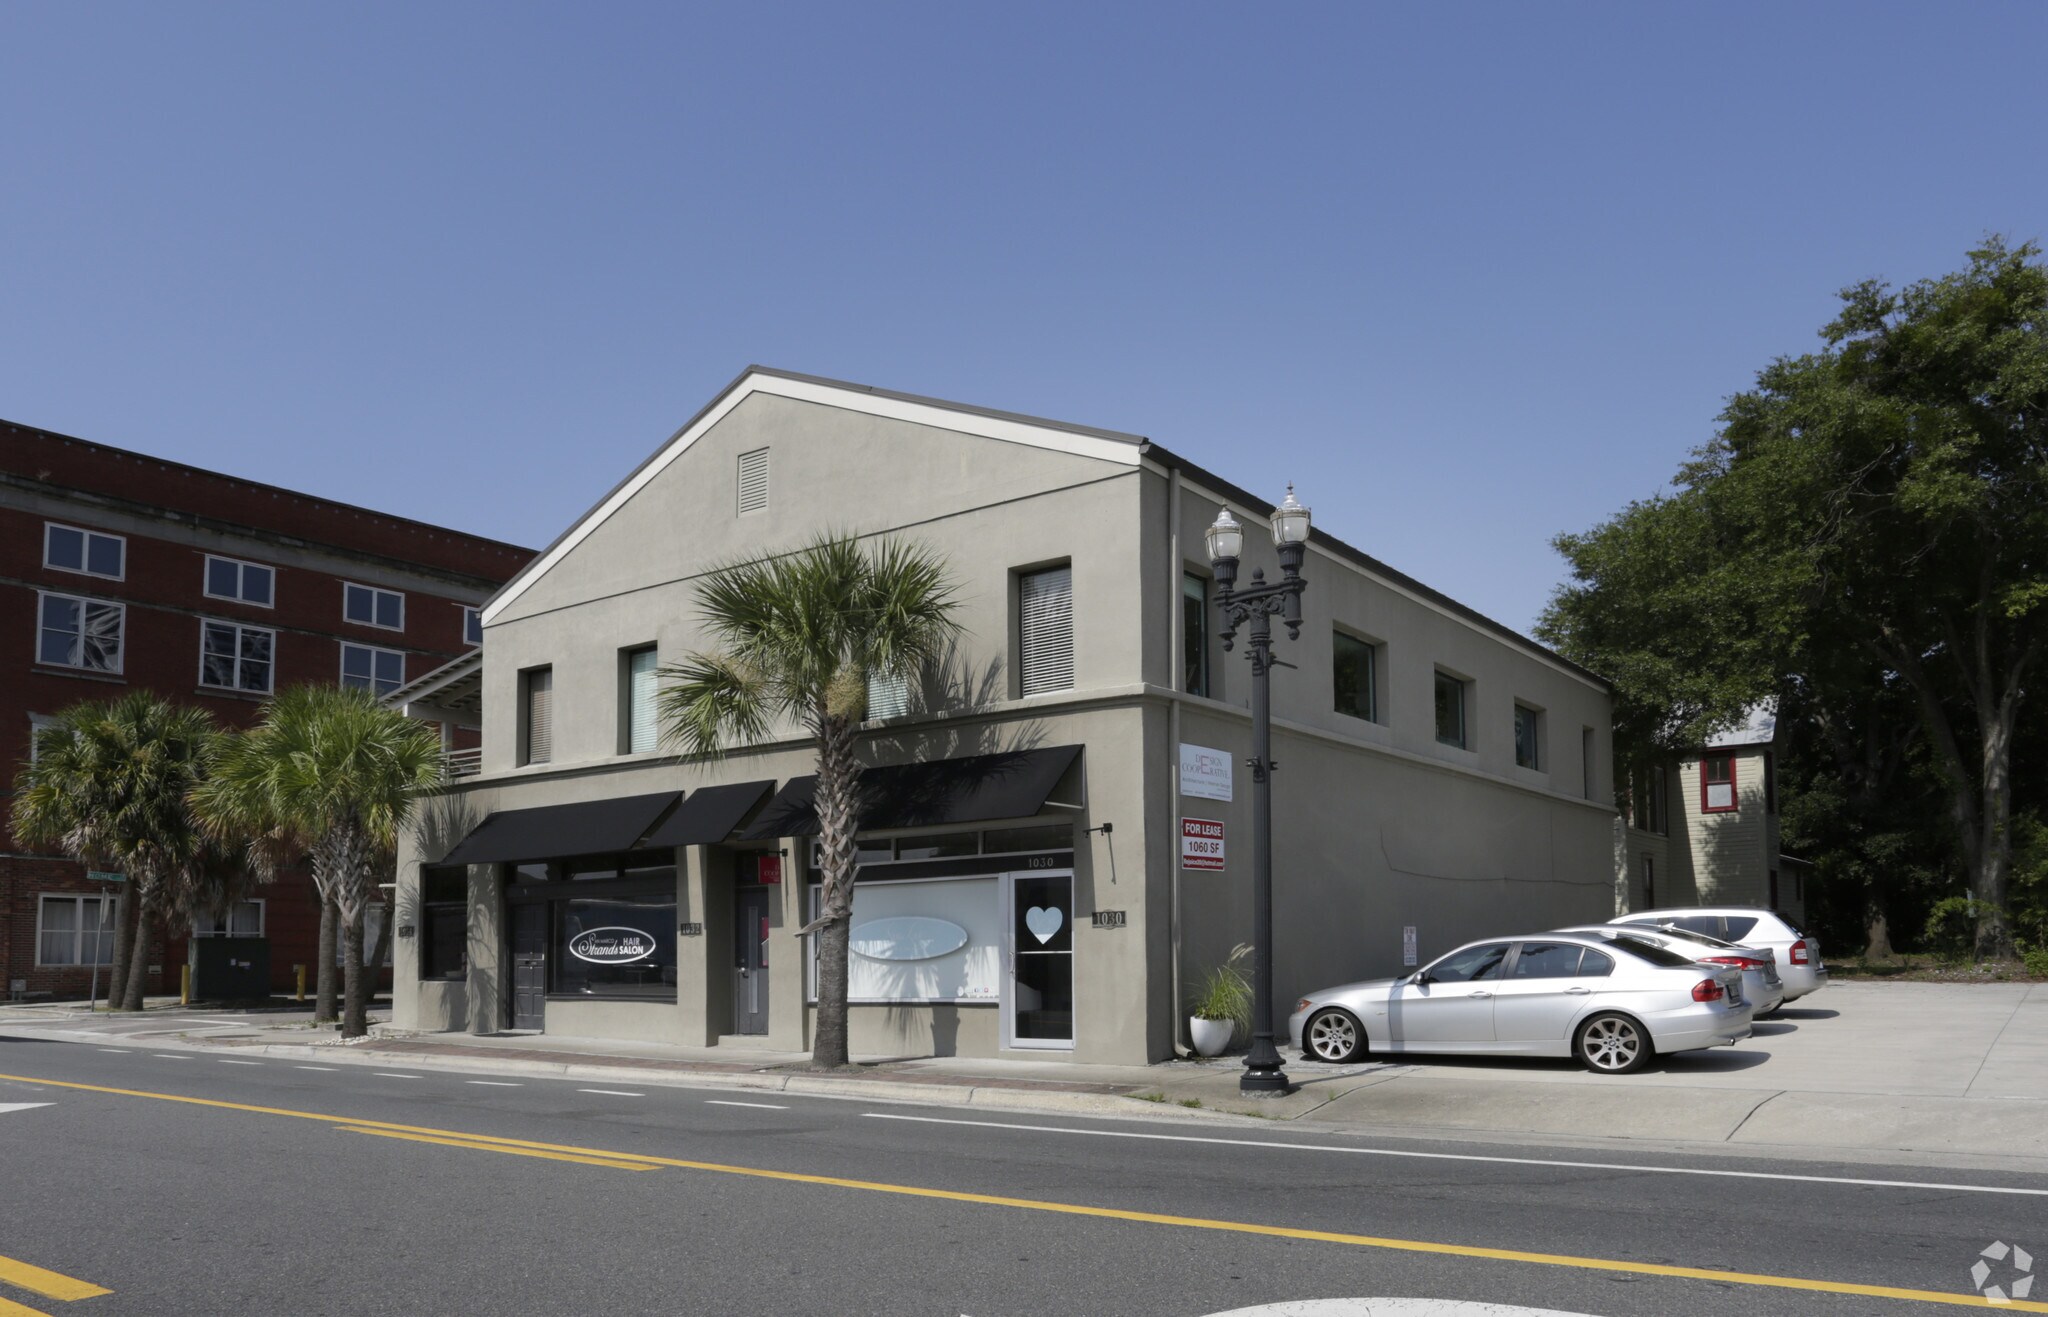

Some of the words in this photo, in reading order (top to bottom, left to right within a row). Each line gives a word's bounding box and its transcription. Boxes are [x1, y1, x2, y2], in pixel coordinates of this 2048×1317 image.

[1185, 823, 1201, 835] FOR
[1202, 824, 1222, 836] LEASE
[1188, 841, 1208, 853] 1060
[1210, 842, 1220, 854] SF
[1028, 857, 1054, 868] 1030
[1096, 911, 1123, 925] 1030
[682, 923, 700, 934] 1032
[578, 933, 618, 956] Strands
[623, 937, 640, 946] HAIR
[619, 945, 644, 955] SALON
